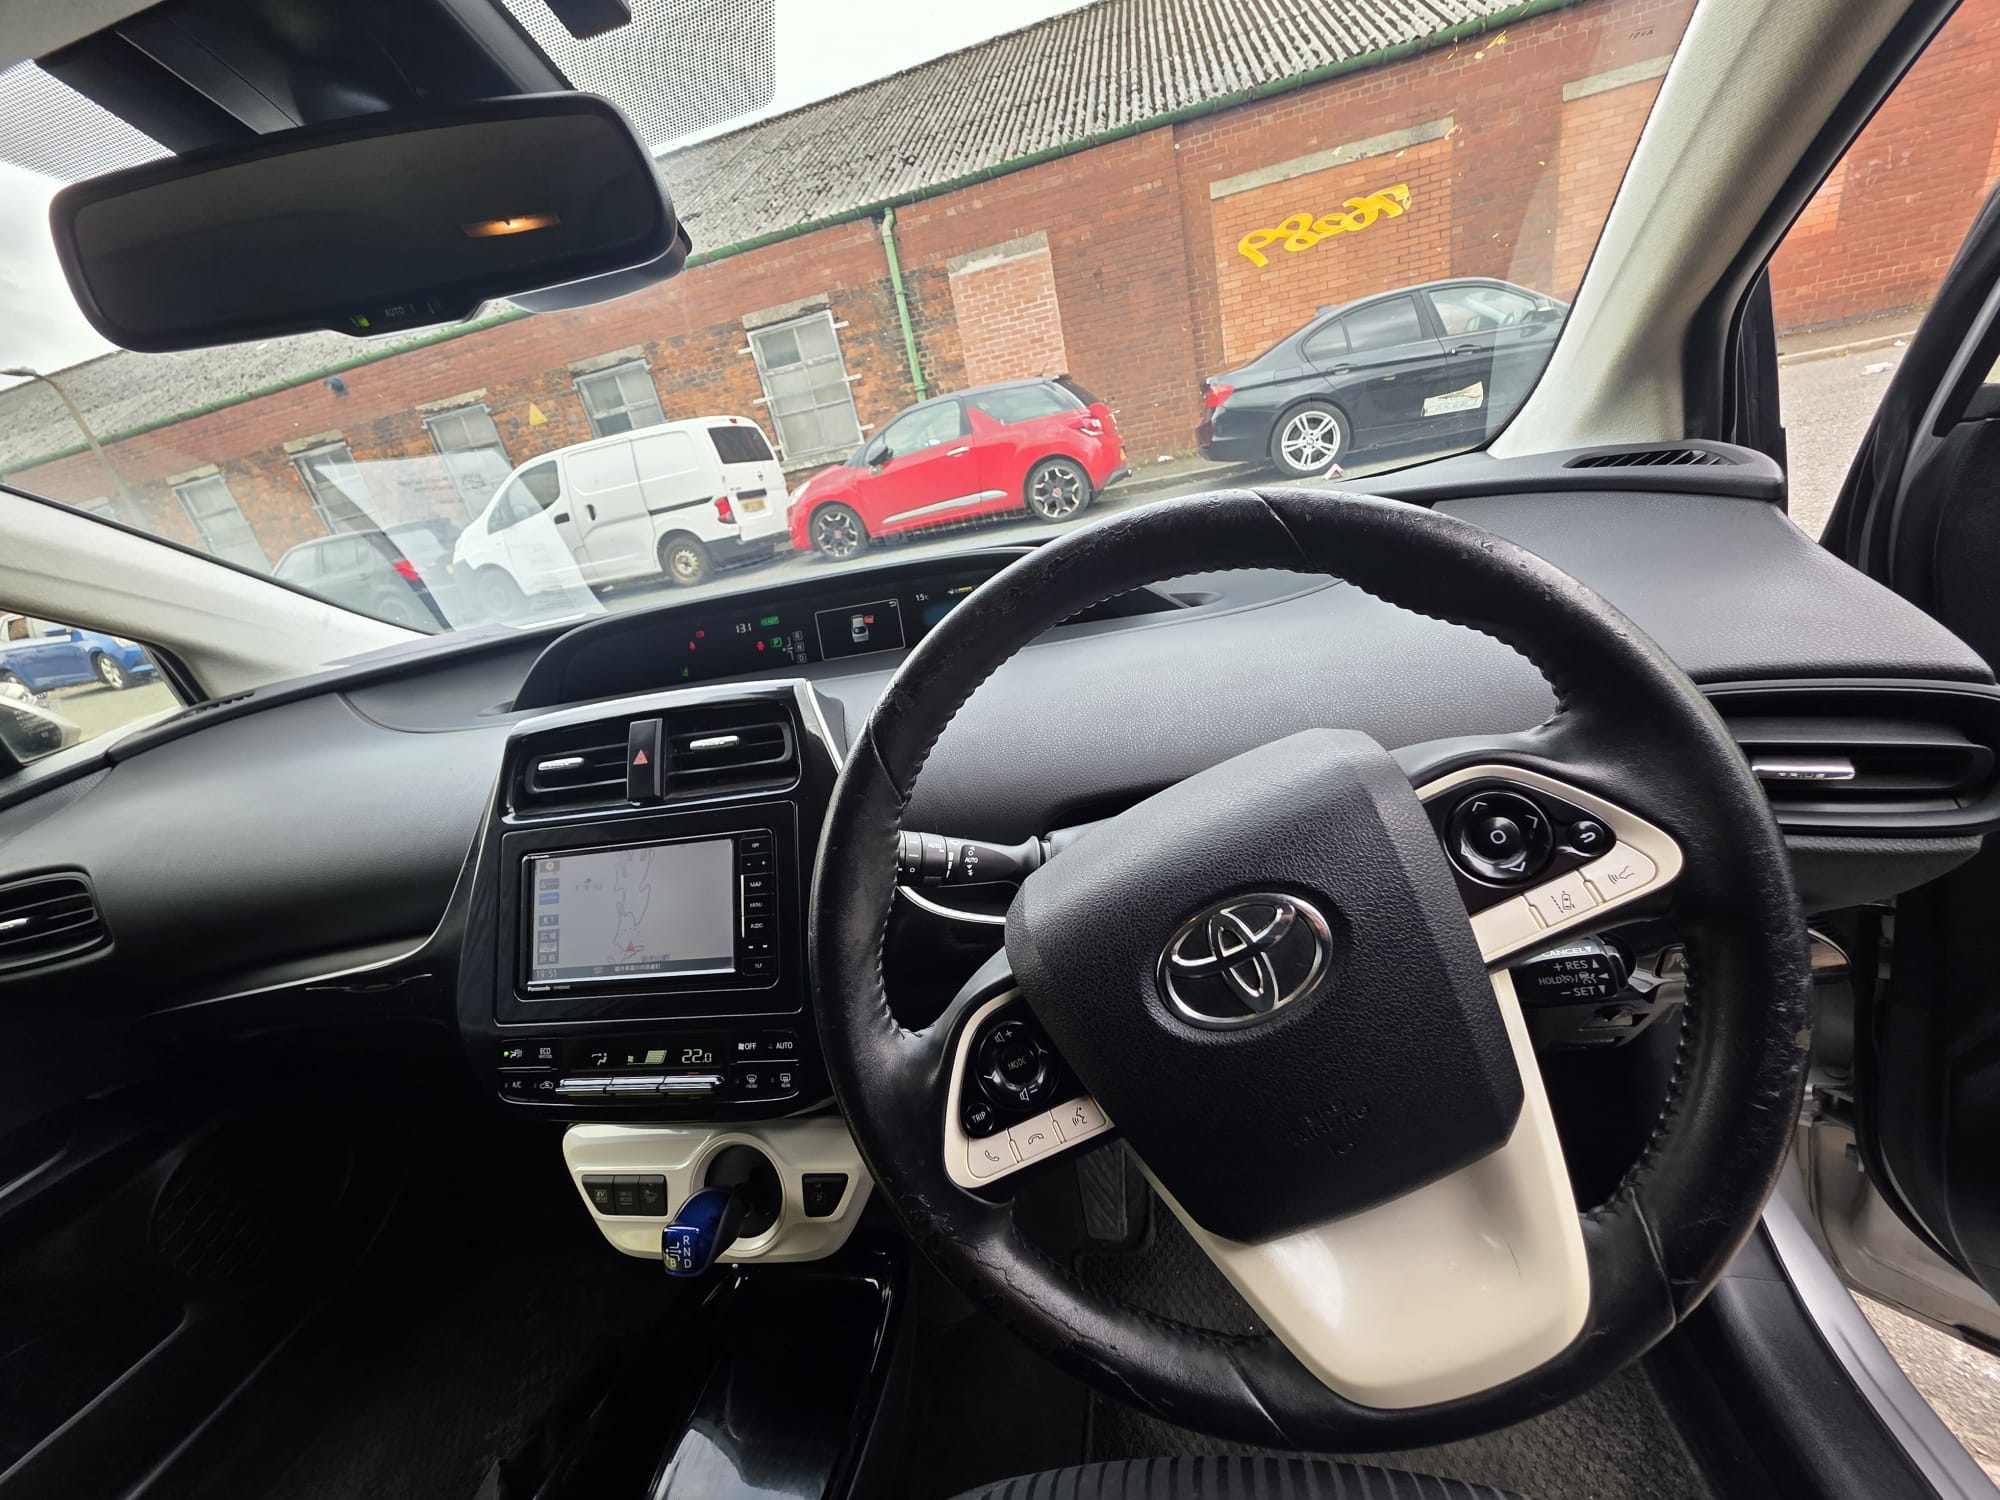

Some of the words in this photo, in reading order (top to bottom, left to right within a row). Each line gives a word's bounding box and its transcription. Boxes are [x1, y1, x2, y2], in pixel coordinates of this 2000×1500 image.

[735, 623, 752, 634] 131
[1565, 960, 1588, 970] RES
[1538, 976, 1563, 984] HOLD
[1573, 986, 1595, 996] SET
[681, 1048, 712, 1064] 22.0
[1008, 1056, 1027, 1070] MODE
[971, 1111, 986, 1124] TRIP
[683, 1236, 690, 1245] R
[684, 1248, 691, 1256] N
[670, 1258, 677, 1268] B
[684, 1259, 692, 1268] D
